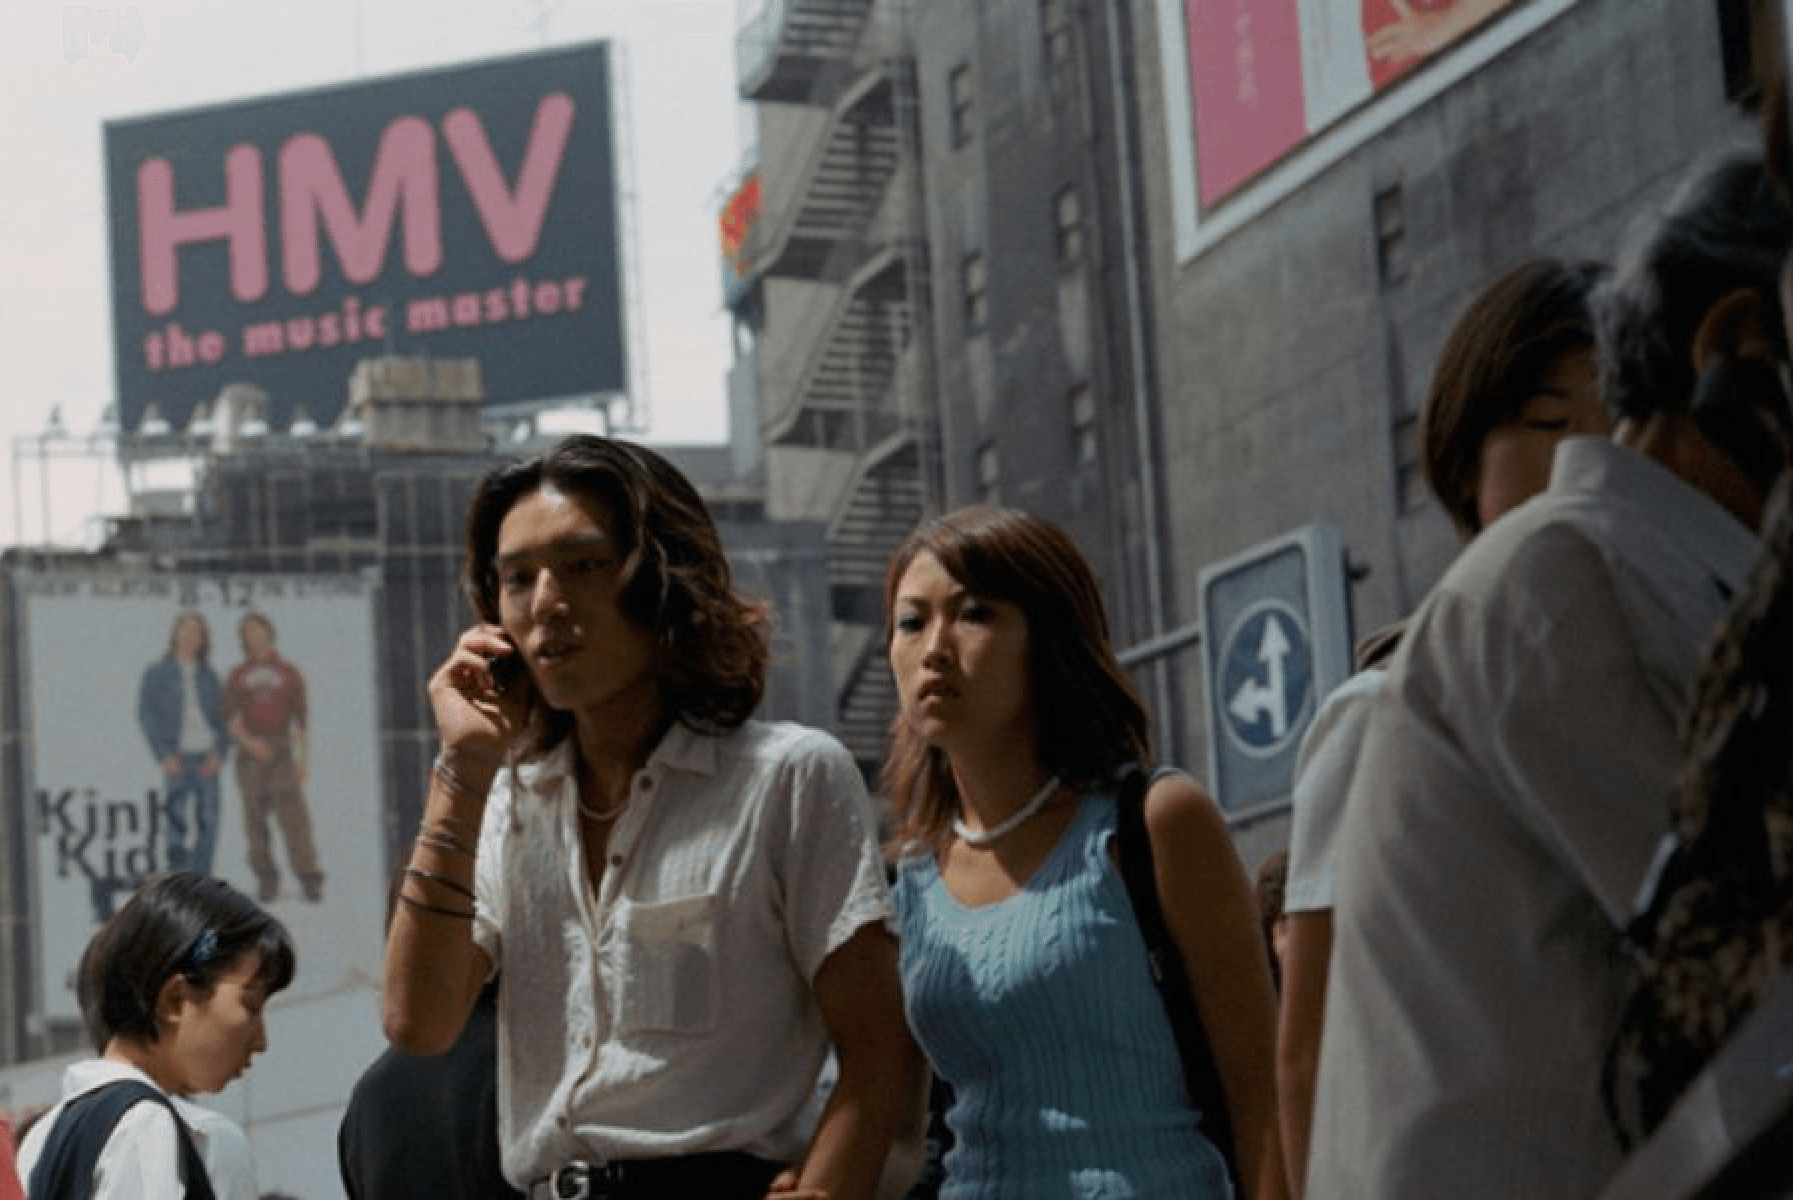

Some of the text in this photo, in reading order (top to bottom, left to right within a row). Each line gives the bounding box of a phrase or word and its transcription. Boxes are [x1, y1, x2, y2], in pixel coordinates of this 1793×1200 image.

[138, 91, 575, 316] HMV
[144, 276, 587, 370] the music master
[58, 831, 172, 881] Kid
